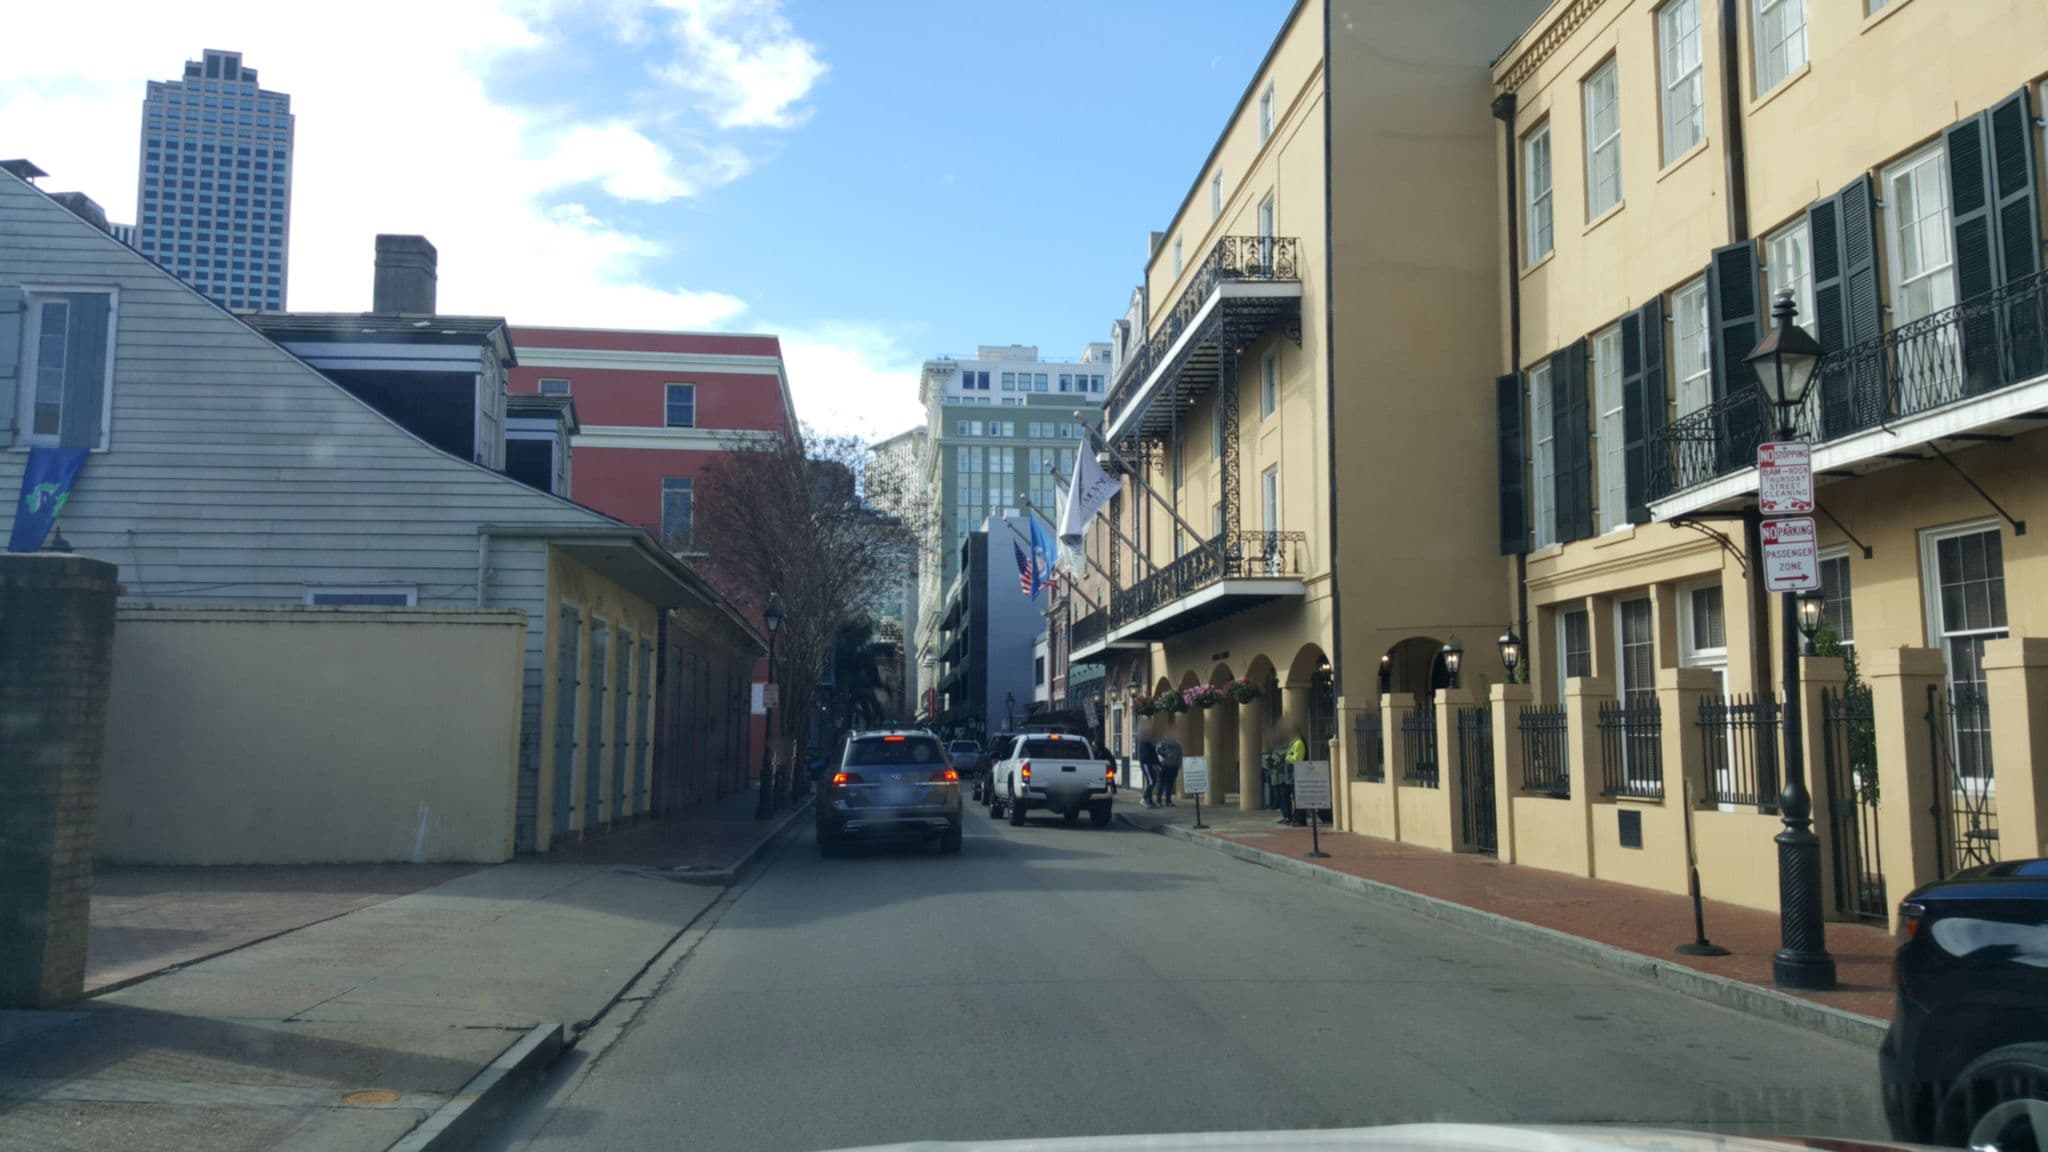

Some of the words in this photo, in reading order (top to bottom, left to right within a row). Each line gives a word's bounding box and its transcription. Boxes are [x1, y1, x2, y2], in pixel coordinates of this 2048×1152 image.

[1760, 449, 1774, 462] NO
[1774, 450, 1808, 460] STOPPING
[1766, 475, 1806, 484] THURSDAY
[1769, 482, 1801, 491] STREET
[1764, 489, 1808, 498] CLEANING
[1763, 526, 1777, 540] NO
[1778, 525, 1812, 537] PARKING
[1766, 547, 1813, 559] PASSENGER
[1779, 561, 1803, 572] ZONE
